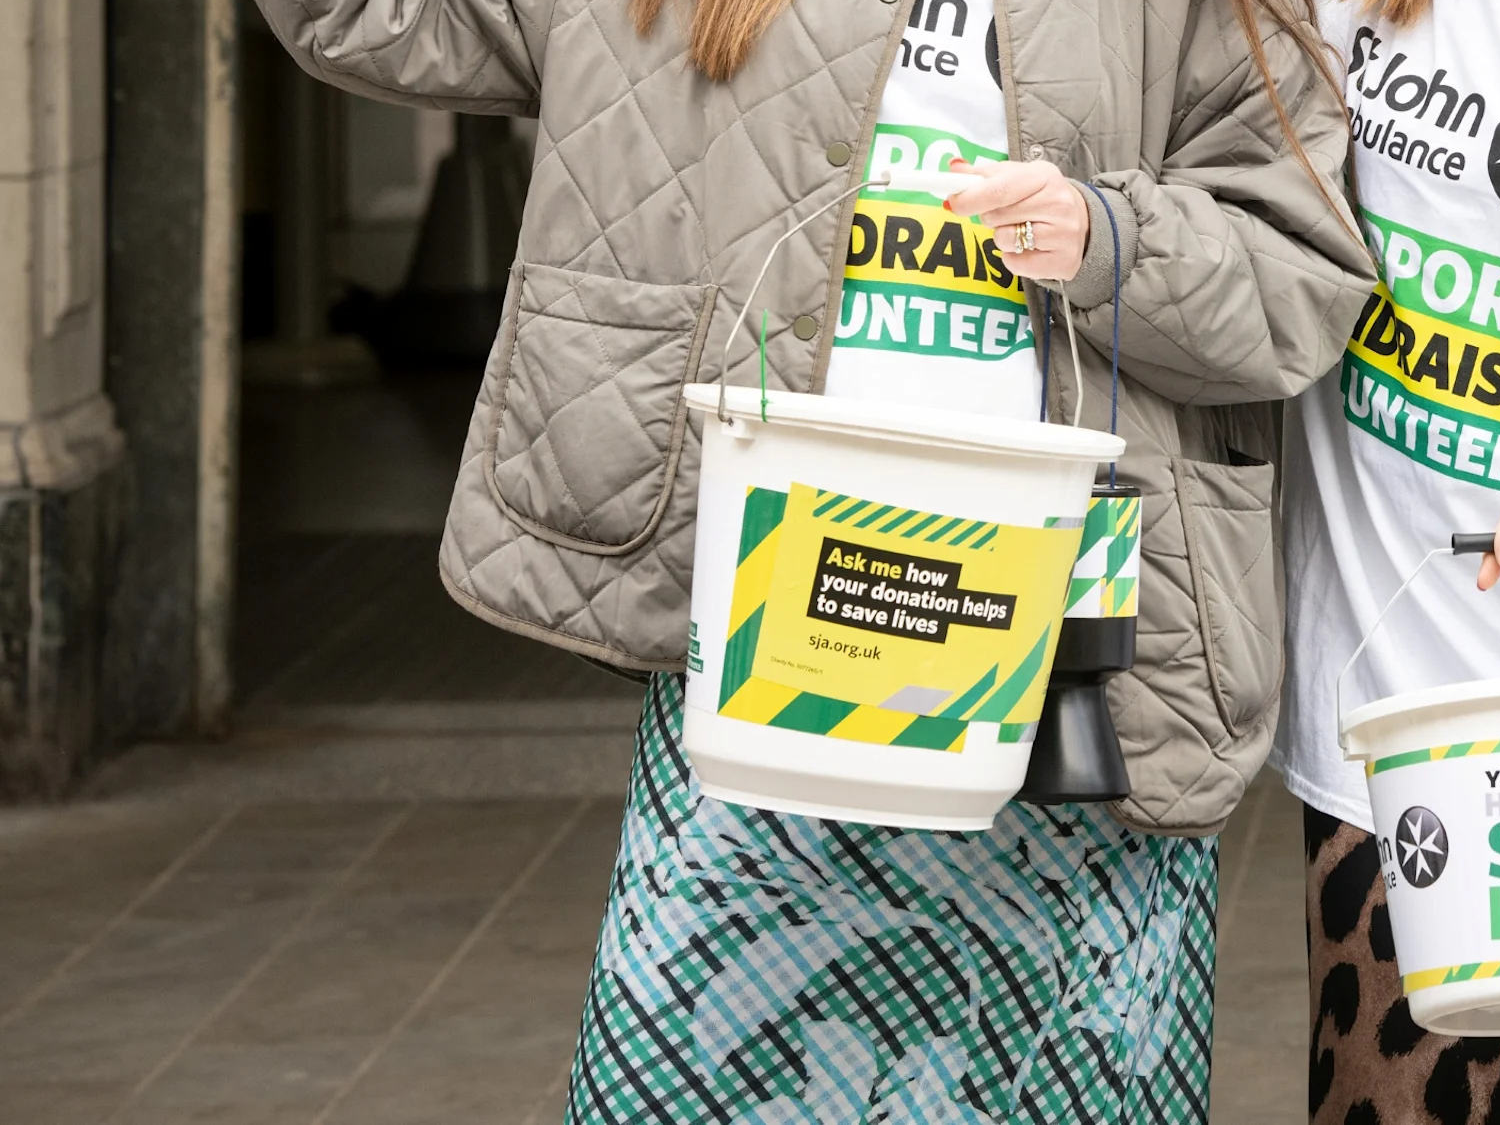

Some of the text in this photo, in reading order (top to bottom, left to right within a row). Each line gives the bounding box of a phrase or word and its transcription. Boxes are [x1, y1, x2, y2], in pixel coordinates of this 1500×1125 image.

[1363, 53, 1486, 138] John
[826, 547, 948, 587] Ask me how
[817, 594, 938, 635] to save lives
[820, 574, 1007, 621] your donation helps
[809, 634, 882, 660] sja.org.uk
